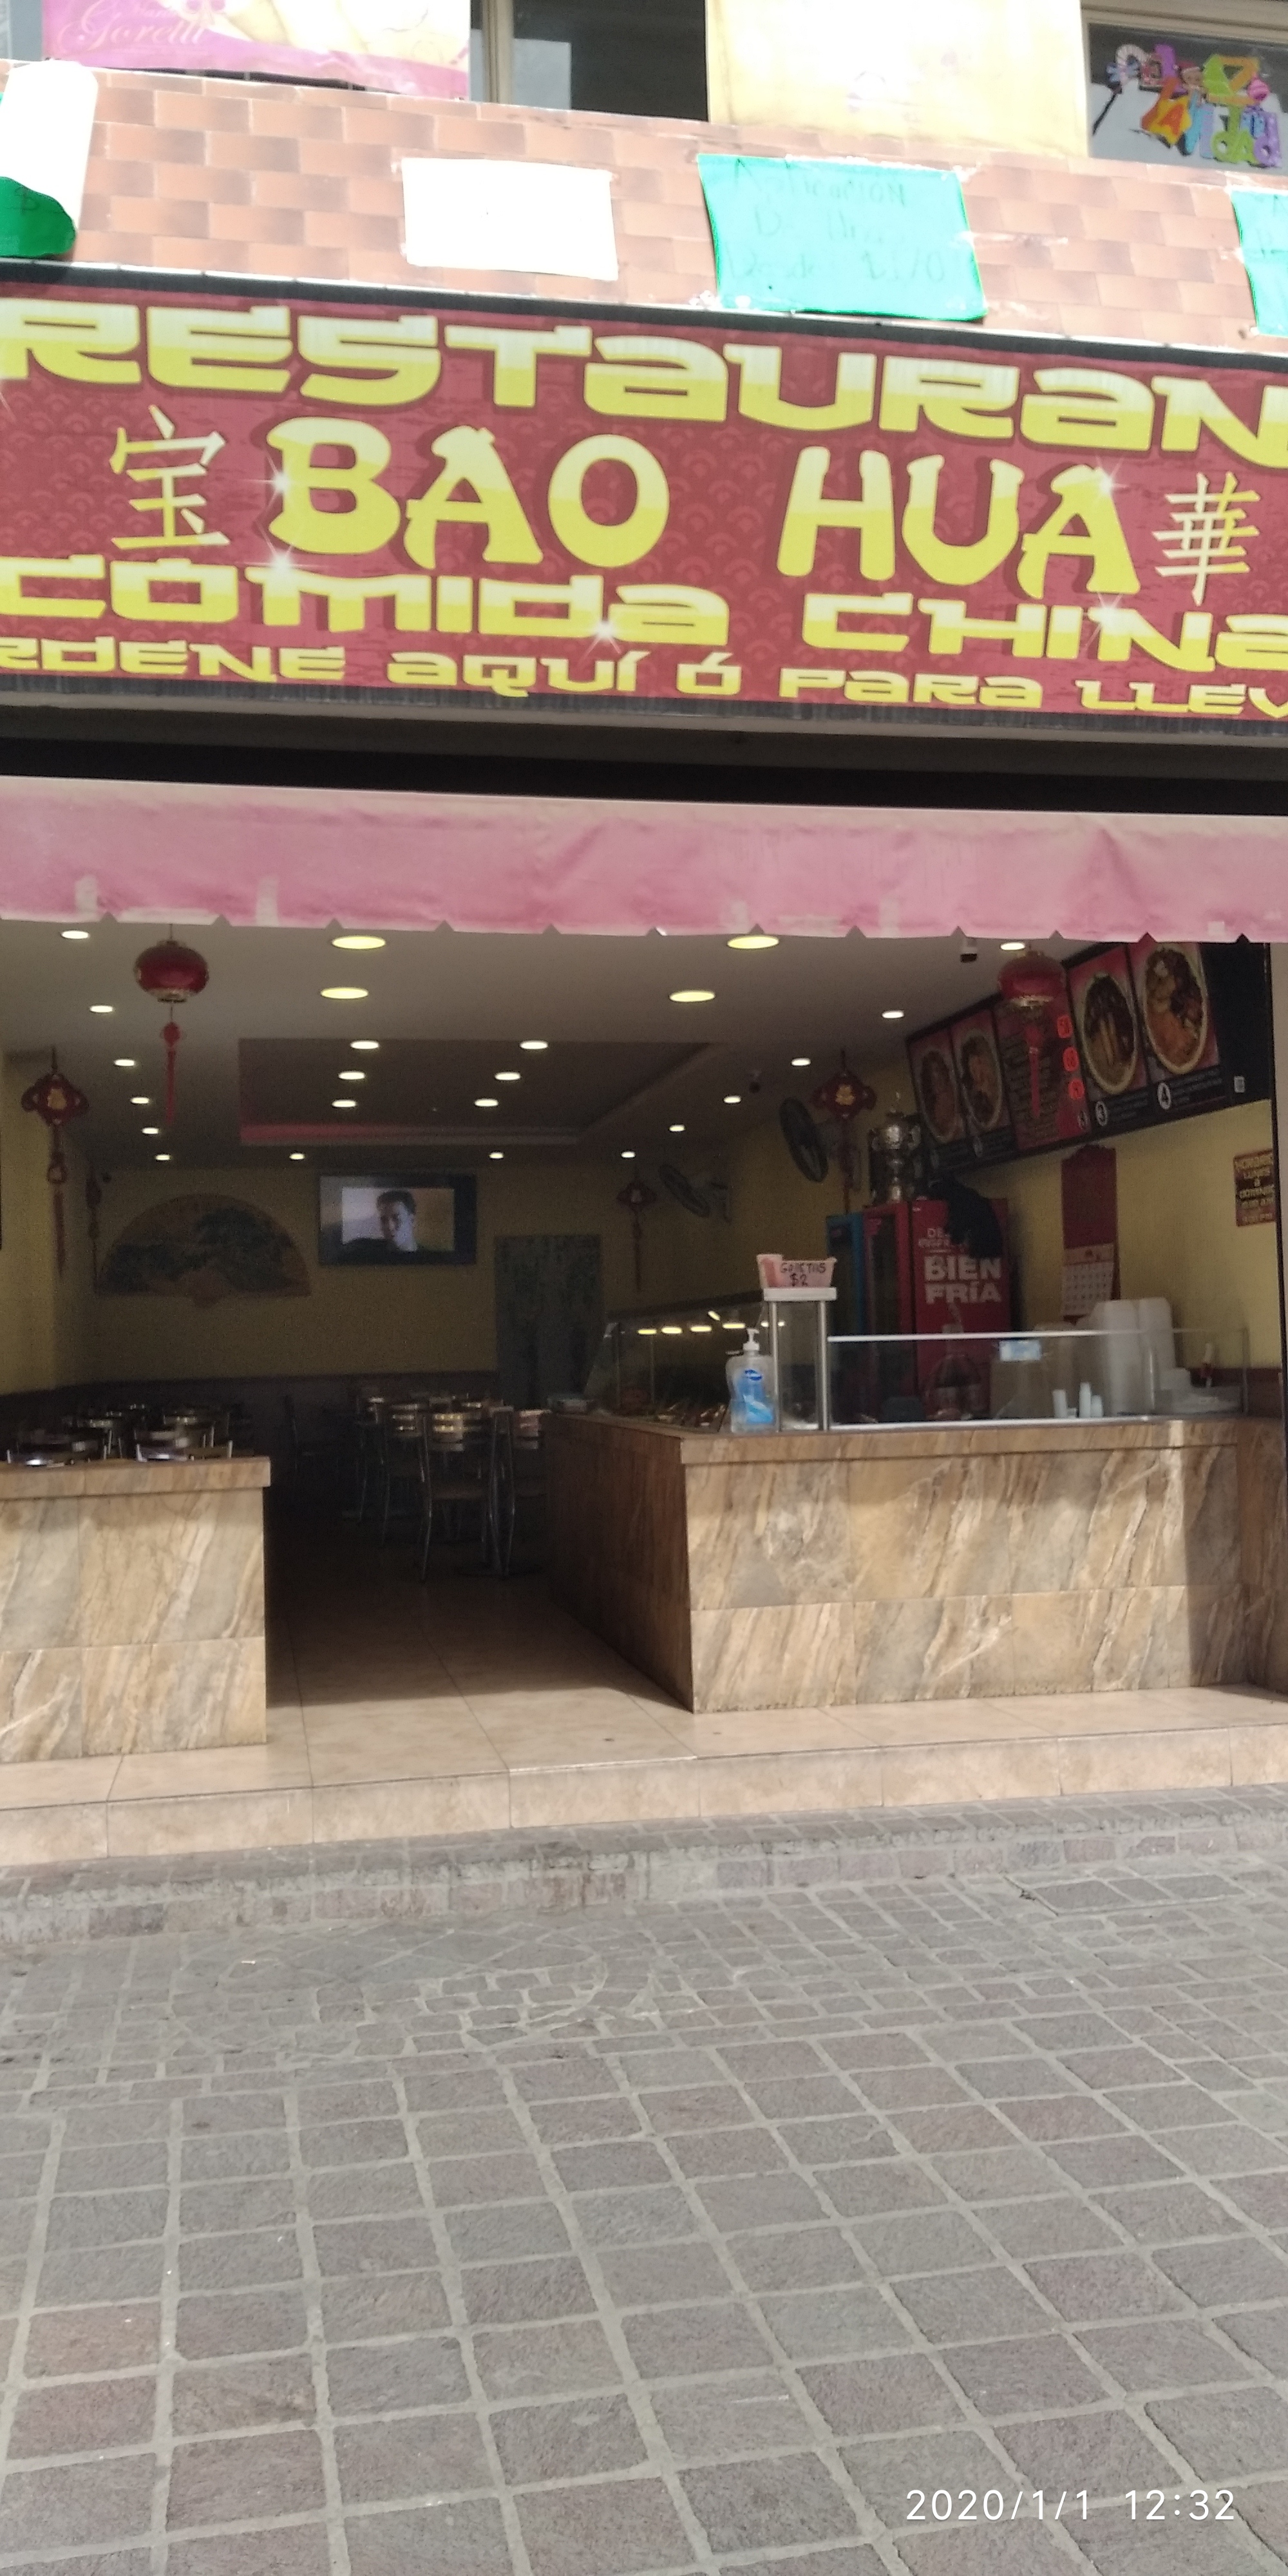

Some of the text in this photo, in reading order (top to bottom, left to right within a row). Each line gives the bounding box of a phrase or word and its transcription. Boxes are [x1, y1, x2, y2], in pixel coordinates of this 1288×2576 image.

[109, 404, 231, 550] 宝
[266, 416, 1141, 599] BAO HUA
[1153, 471, 1260, 607] 華
[924, 1255, 1001, 1282] BIEN
[925, 1281, 1002, 1306] FRÍA
